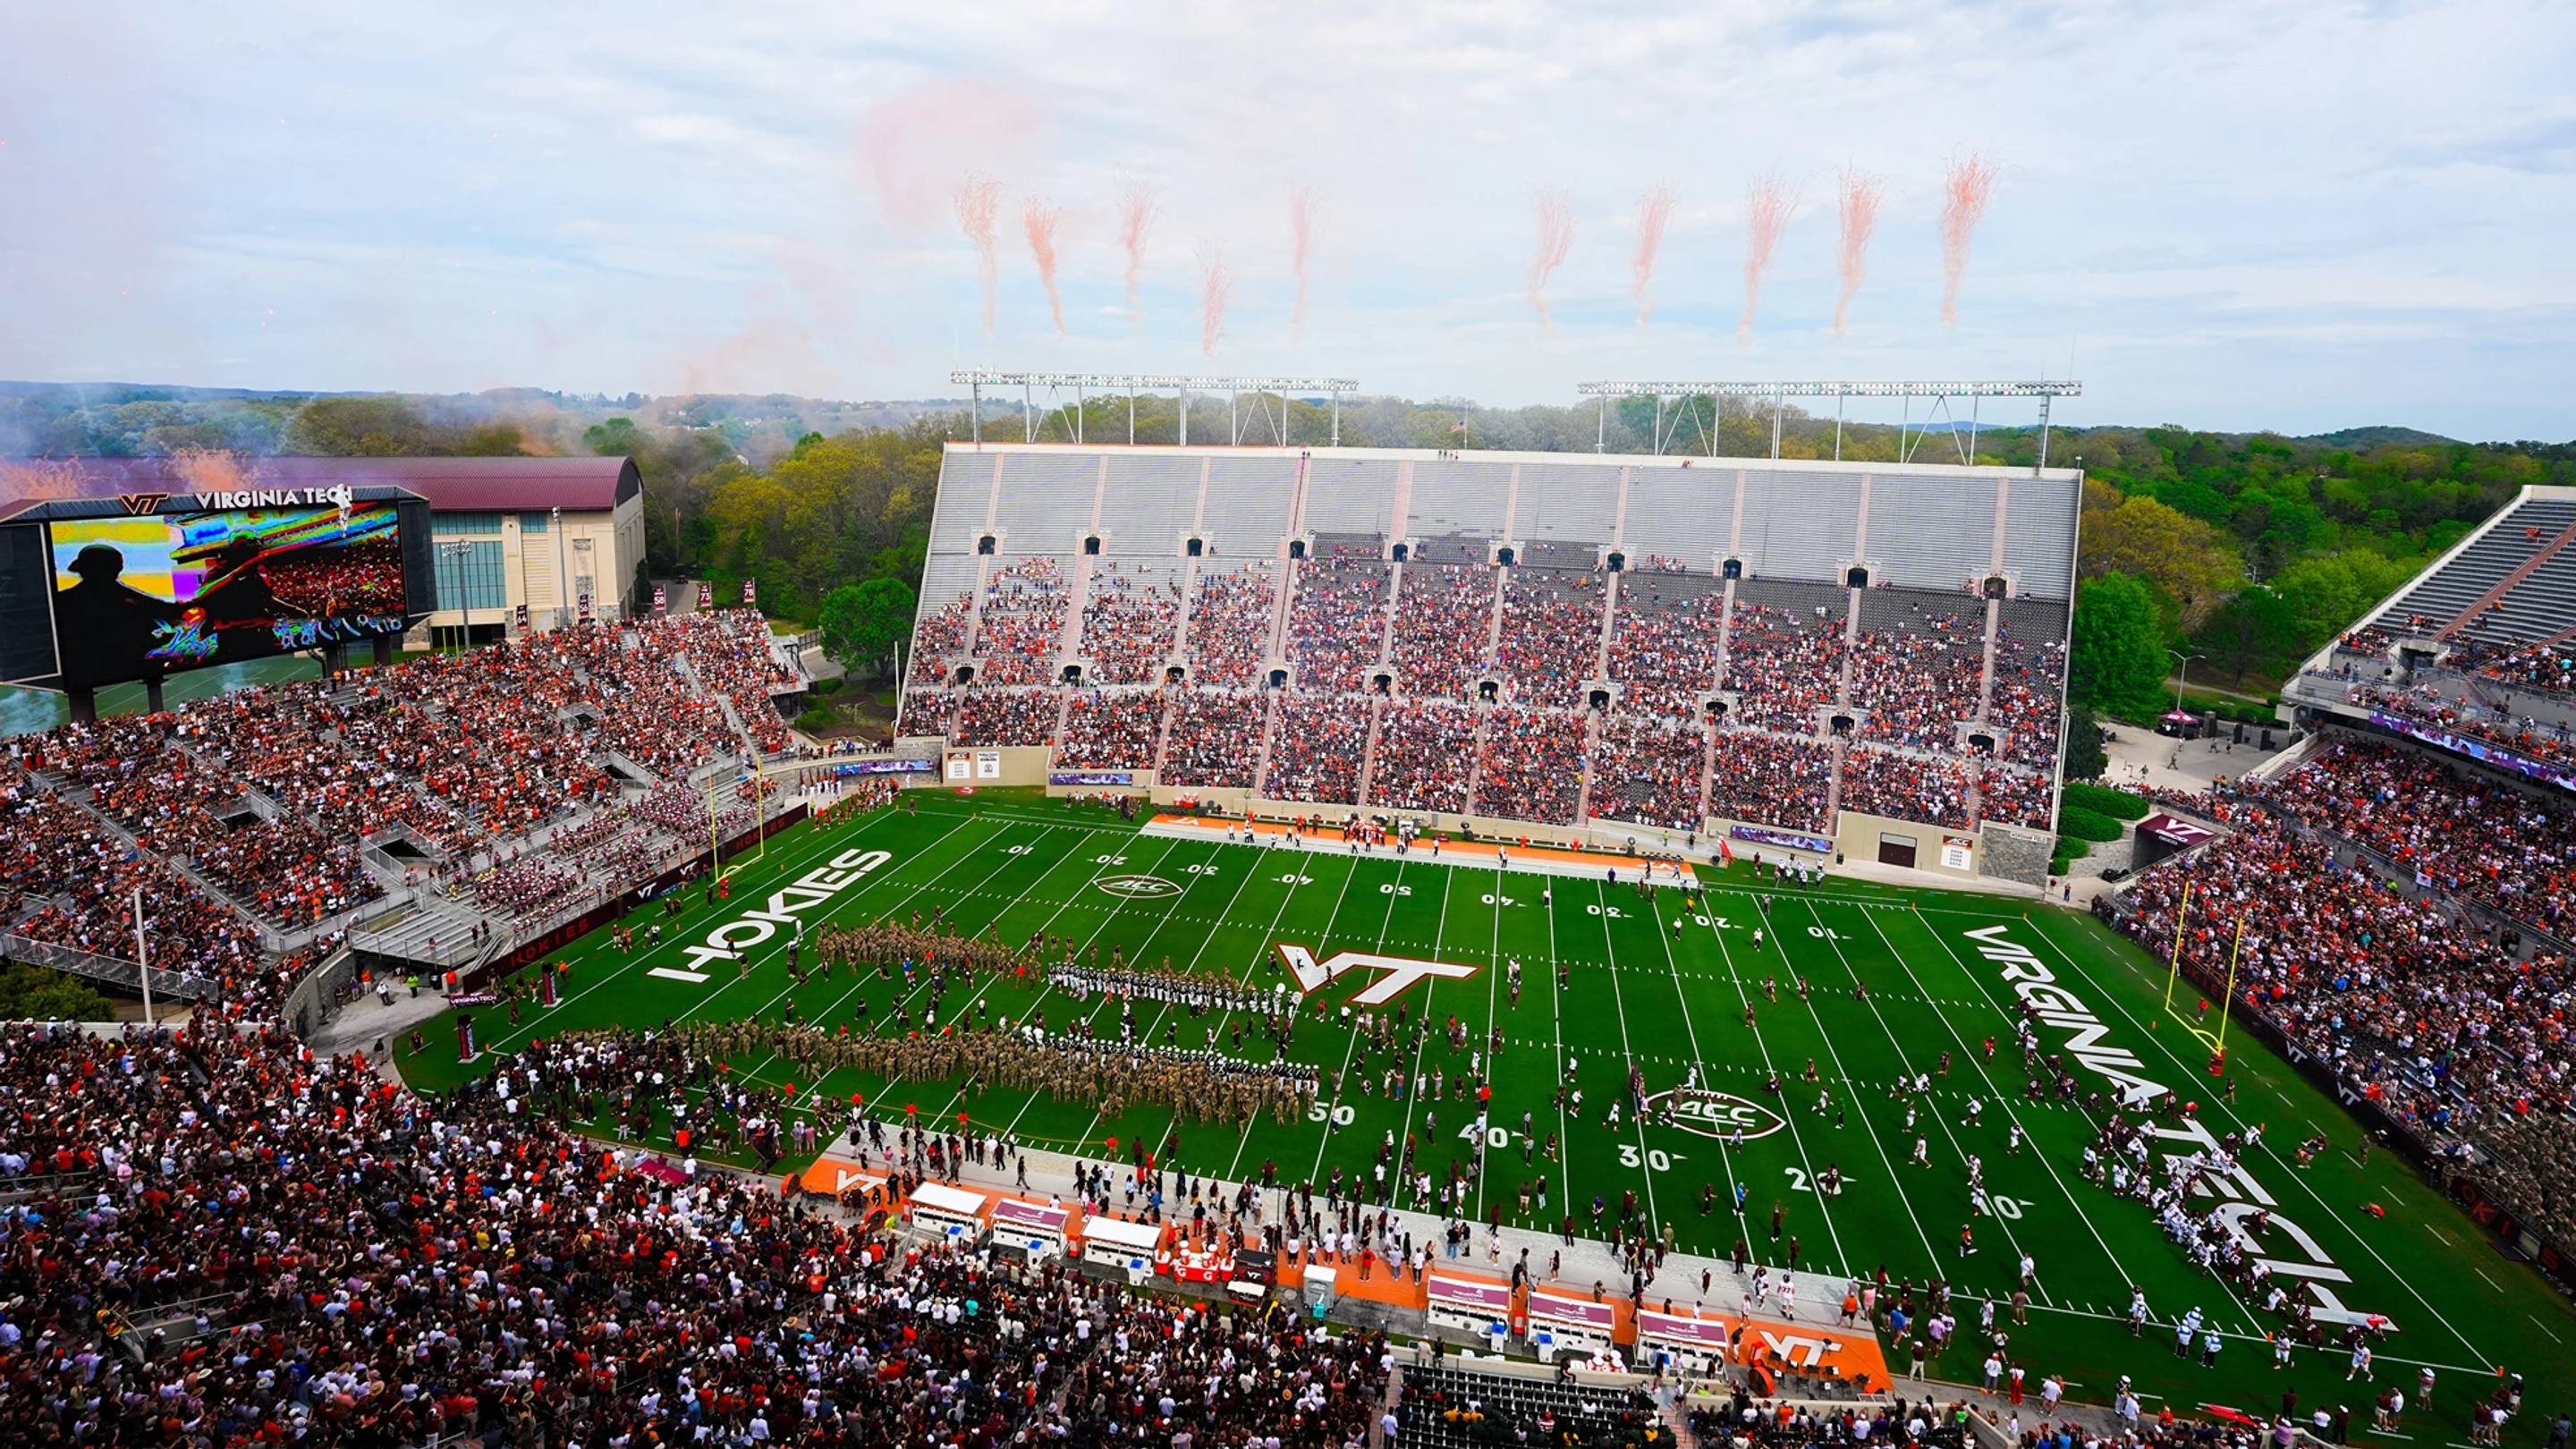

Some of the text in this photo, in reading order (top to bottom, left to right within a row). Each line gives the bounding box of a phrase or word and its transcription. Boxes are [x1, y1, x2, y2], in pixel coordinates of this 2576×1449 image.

[120, 494, 170, 514] VT
[193, 486, 352, 510] VIRGINIA TECH
[654, 596, 665, 605] 58
[2165, 818, 2216, 836] VT
[1008, 845, 1034, 855] 10
[1949, 838, 1969, 846] ACC
[680, 860, 698, 876] VT
[1096, 854, 1129, 866] 20
[1187, 864, 1219, 877] 30
[1108, 879, 1170, 893] ACC
[1281, 874, 1315, 886] 40
[638, 882, 657, 899] VT
[1379, 884, 1412, 896] 50
[1480, 894, 1514, 907] 40
[647, 848, 894, 984] HOKIES
[1586, 904, 1622, 918] 30
[1694, 914, 1733, 928] 20
[1807, 926, 1839, 939] 10
[511, 919, 589, 966] HOKIES
[1275, 943, 1485, 1006] VT
[1962, 925, 2169, 1105] VIRGINIA
[2286, 1040, 2308, 1063] VT
[2336, 1080, 2361, 1106] VT
[1308, 1101, 1355, 1126] 50
[1677, 1100, 1758, 1123] ACC
[1457, 1123, 1509, 1148] 40
[1617, 1143, 1674, 1173] 30
[835, 1168, 888, 1193] VT
[1784, 1166, 1843, 1196] 20
[2149, 1118, 2402, 1332] TECH
[1177, 1268, 1186, 1278] G
[1203, 1271, 1213, 1281] G
[1247, 1271, 1262, 1280] VT
[1758, 1330, 1843, 1367] VT
[446, 1378, 458, 1388] 25
